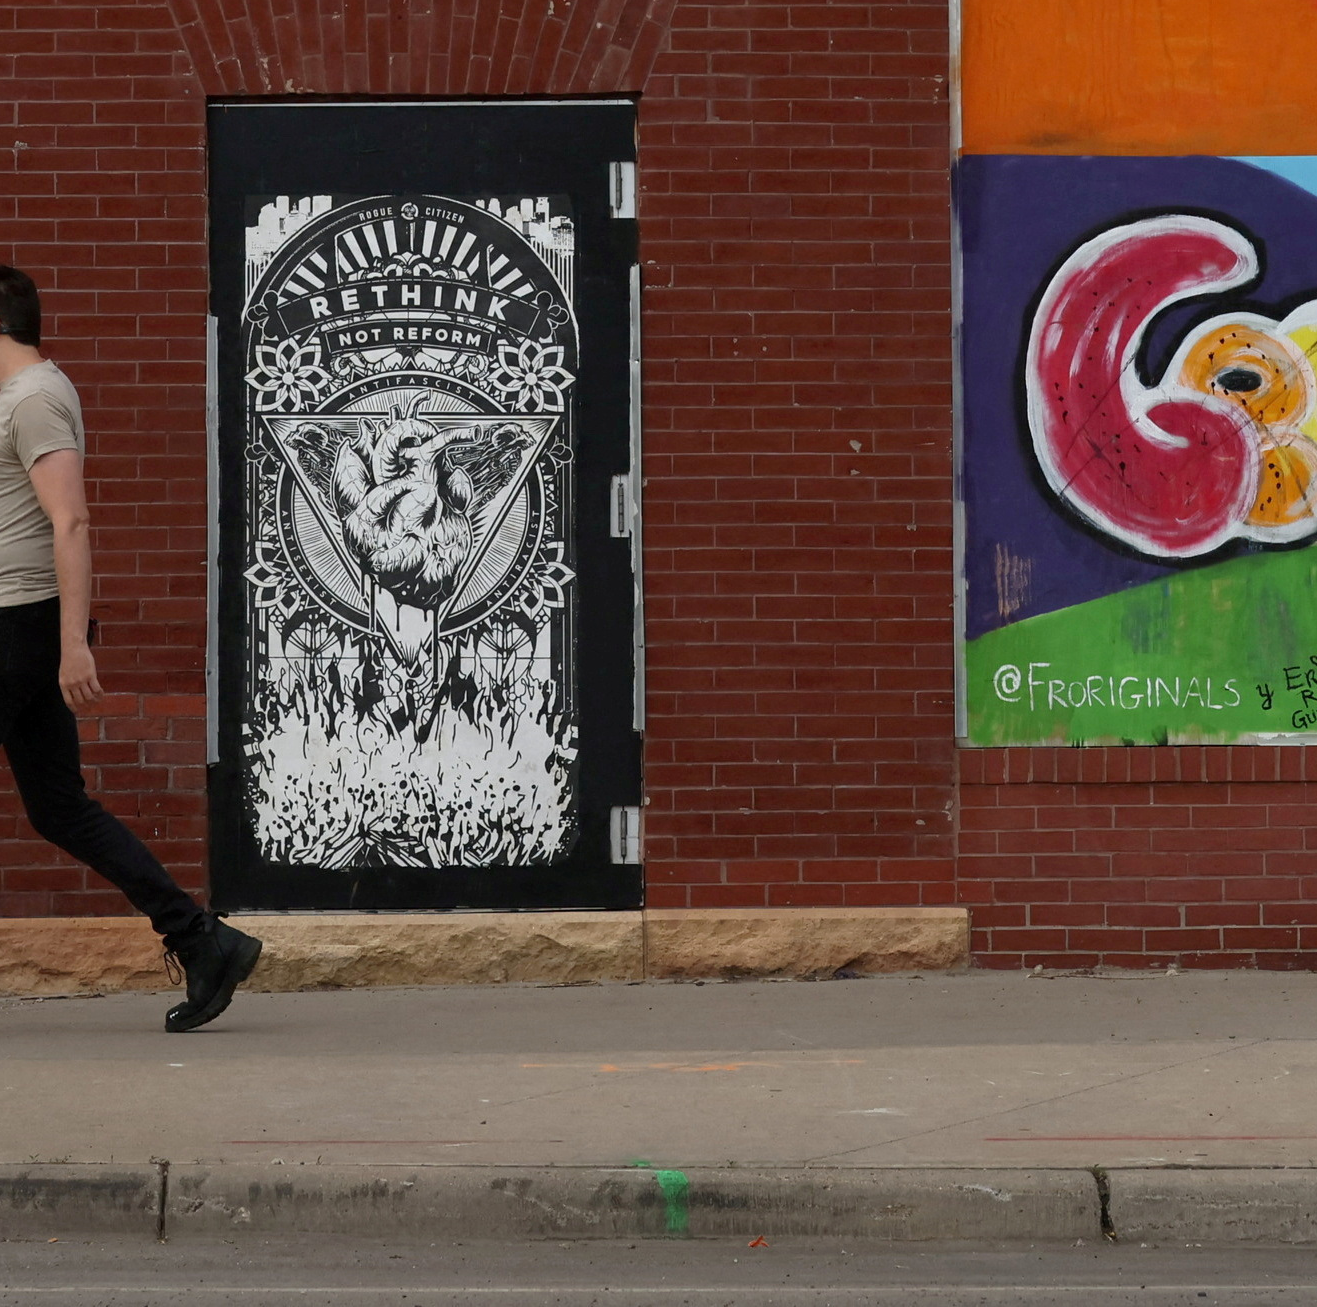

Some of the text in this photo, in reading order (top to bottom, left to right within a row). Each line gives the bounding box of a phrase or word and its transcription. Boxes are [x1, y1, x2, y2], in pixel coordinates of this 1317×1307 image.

[358, 206, 465, 224] ROGUE CITIZEN
[309, 284, 511, 322] RETHINK
[338, 326, 482, 347] NOT REFORM
[348, 377, 476, 400] ANTIFASCIST
[281, 509, 338, 606] ANTISEXIST
[485, 509, 540, 607] ANTIRACIST
